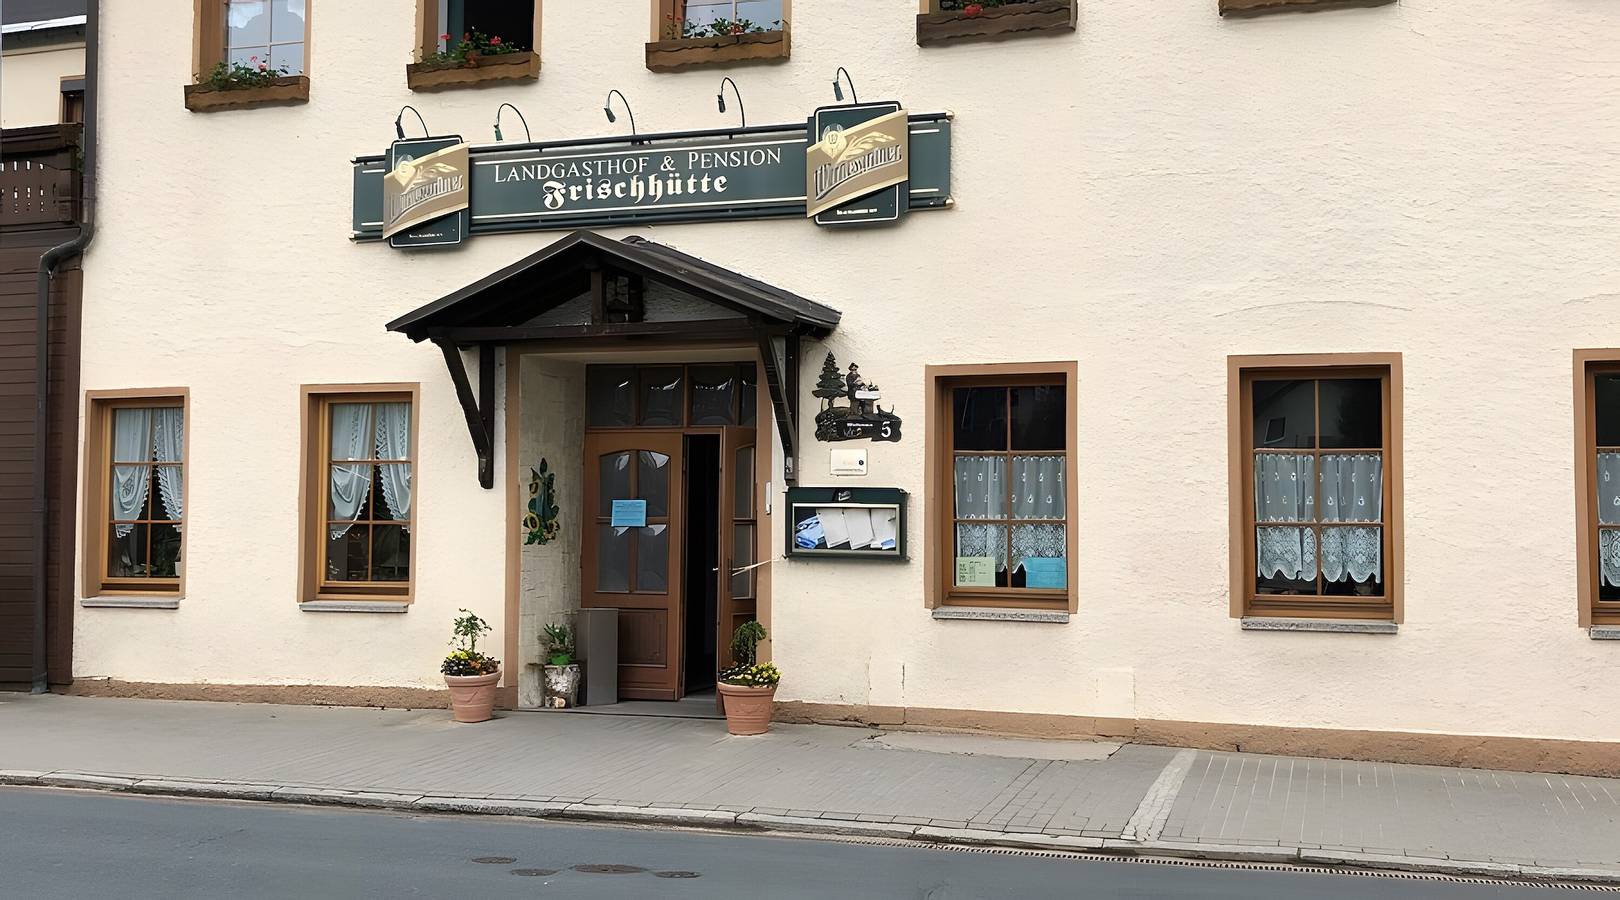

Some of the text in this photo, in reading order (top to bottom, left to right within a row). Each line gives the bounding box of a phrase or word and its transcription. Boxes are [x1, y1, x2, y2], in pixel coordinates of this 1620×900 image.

[494, 147, 781, 183] LANDGASTHOF & PENSION
[542, 172, 728, 209] Frischhütte
[881, 420, 892, 438] 5
